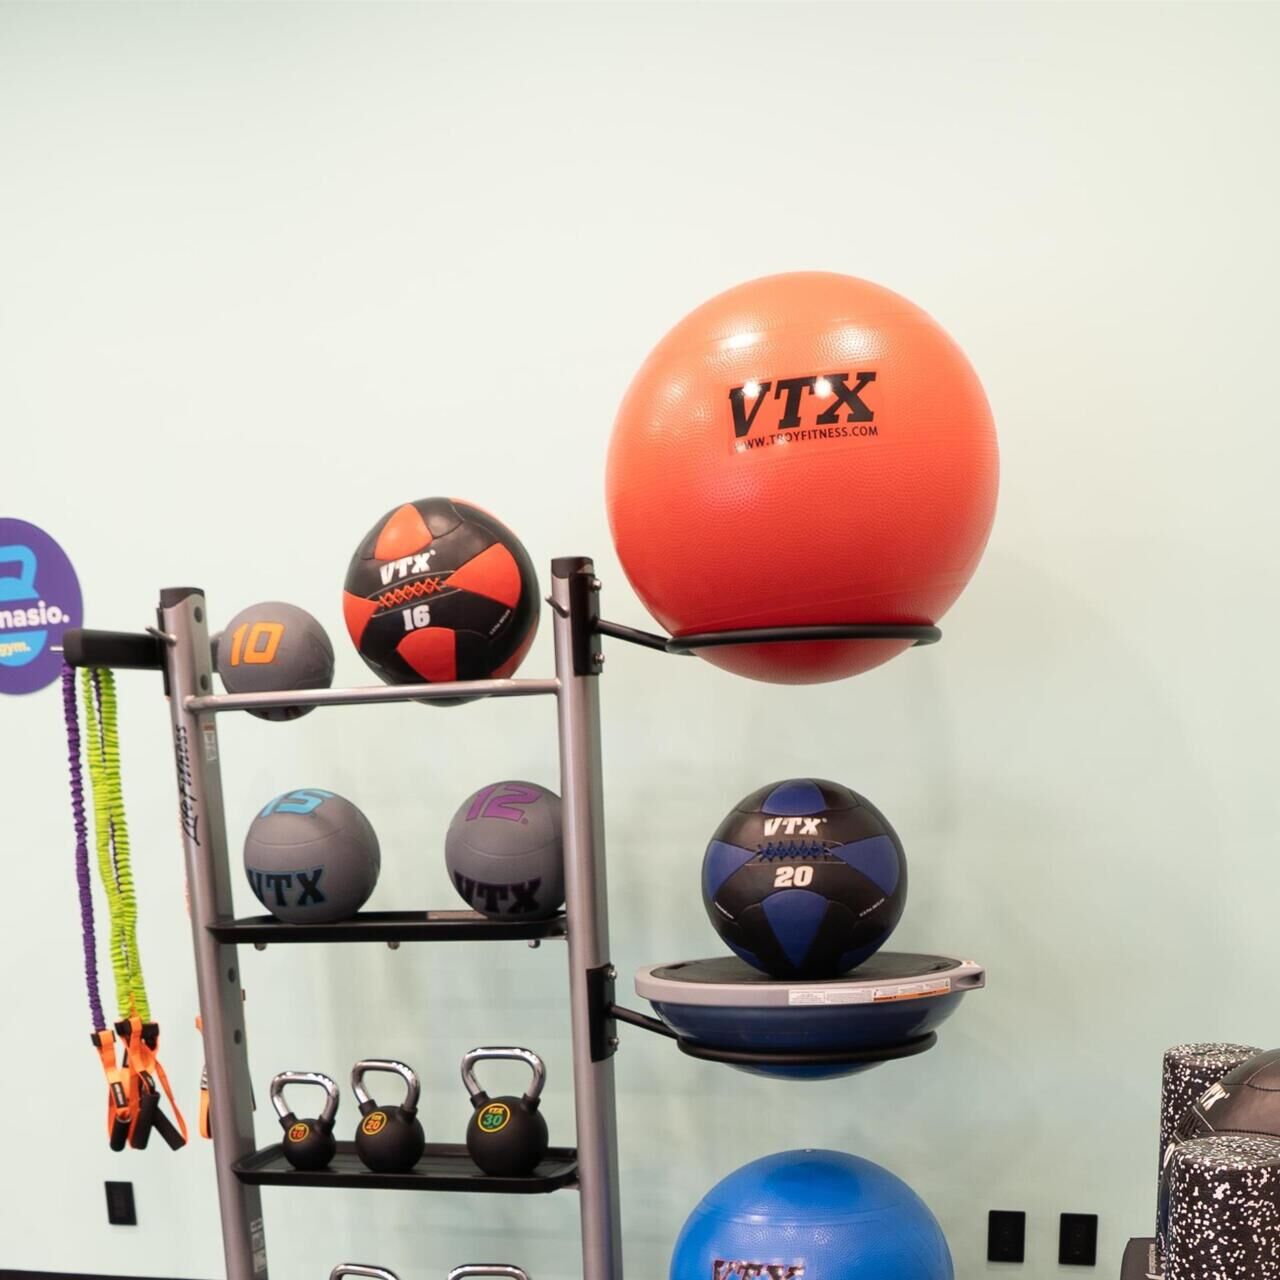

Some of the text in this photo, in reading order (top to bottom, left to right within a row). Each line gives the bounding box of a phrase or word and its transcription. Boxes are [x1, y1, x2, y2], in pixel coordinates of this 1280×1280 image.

[728, 371, 877, 438] VTX
[379, 551, 433, 586] VTX
[402, 604, 430, 631] 16
[230, 622, 286, 667] 10
[465, 784, 543, 822] 12
[764, 817, 822, 837] VTX
[773, 865, 814, 888] 20
[366, 1120, 381, 1130] 20
[483, 1113, 503, 1126] 30
